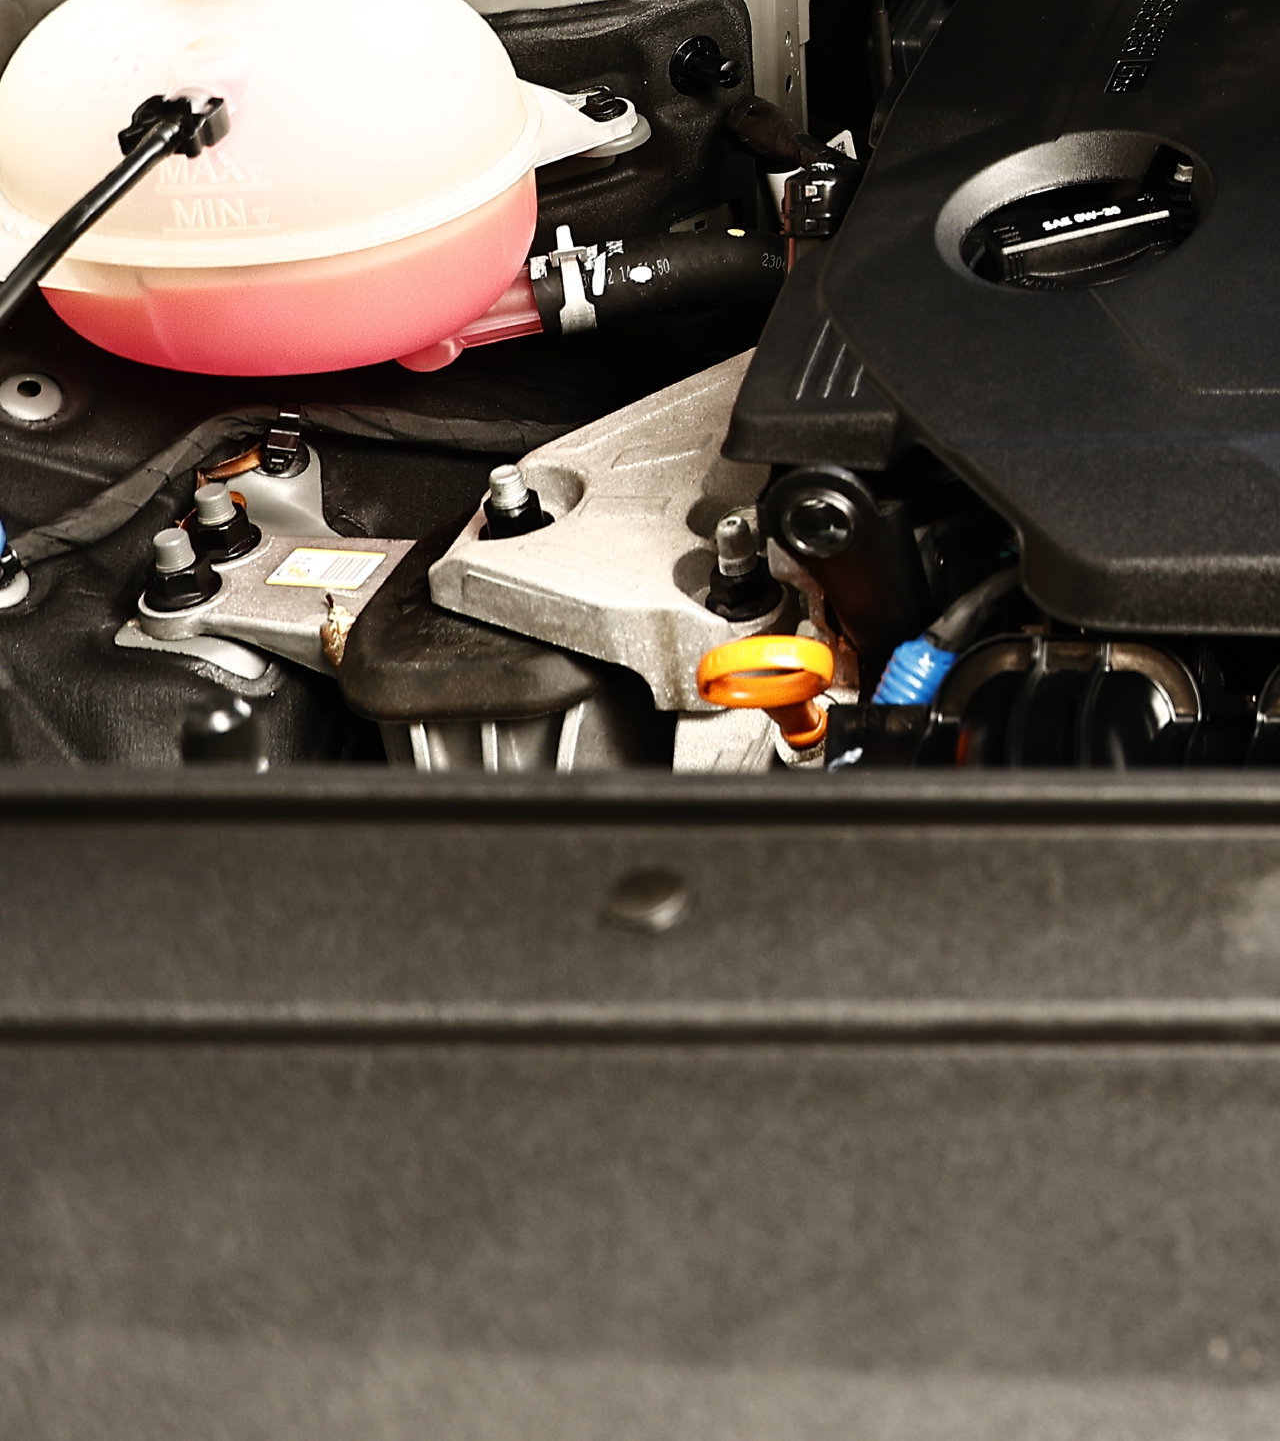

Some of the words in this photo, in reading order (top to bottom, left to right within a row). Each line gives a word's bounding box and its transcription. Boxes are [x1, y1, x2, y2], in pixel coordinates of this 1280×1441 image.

[159, 149, 247, 185] MAX
[171, 197, 248, 229] MIN
[1041, 215, 1073, 232] SAE
[1073, 205, 1122, 224] 0W-20
